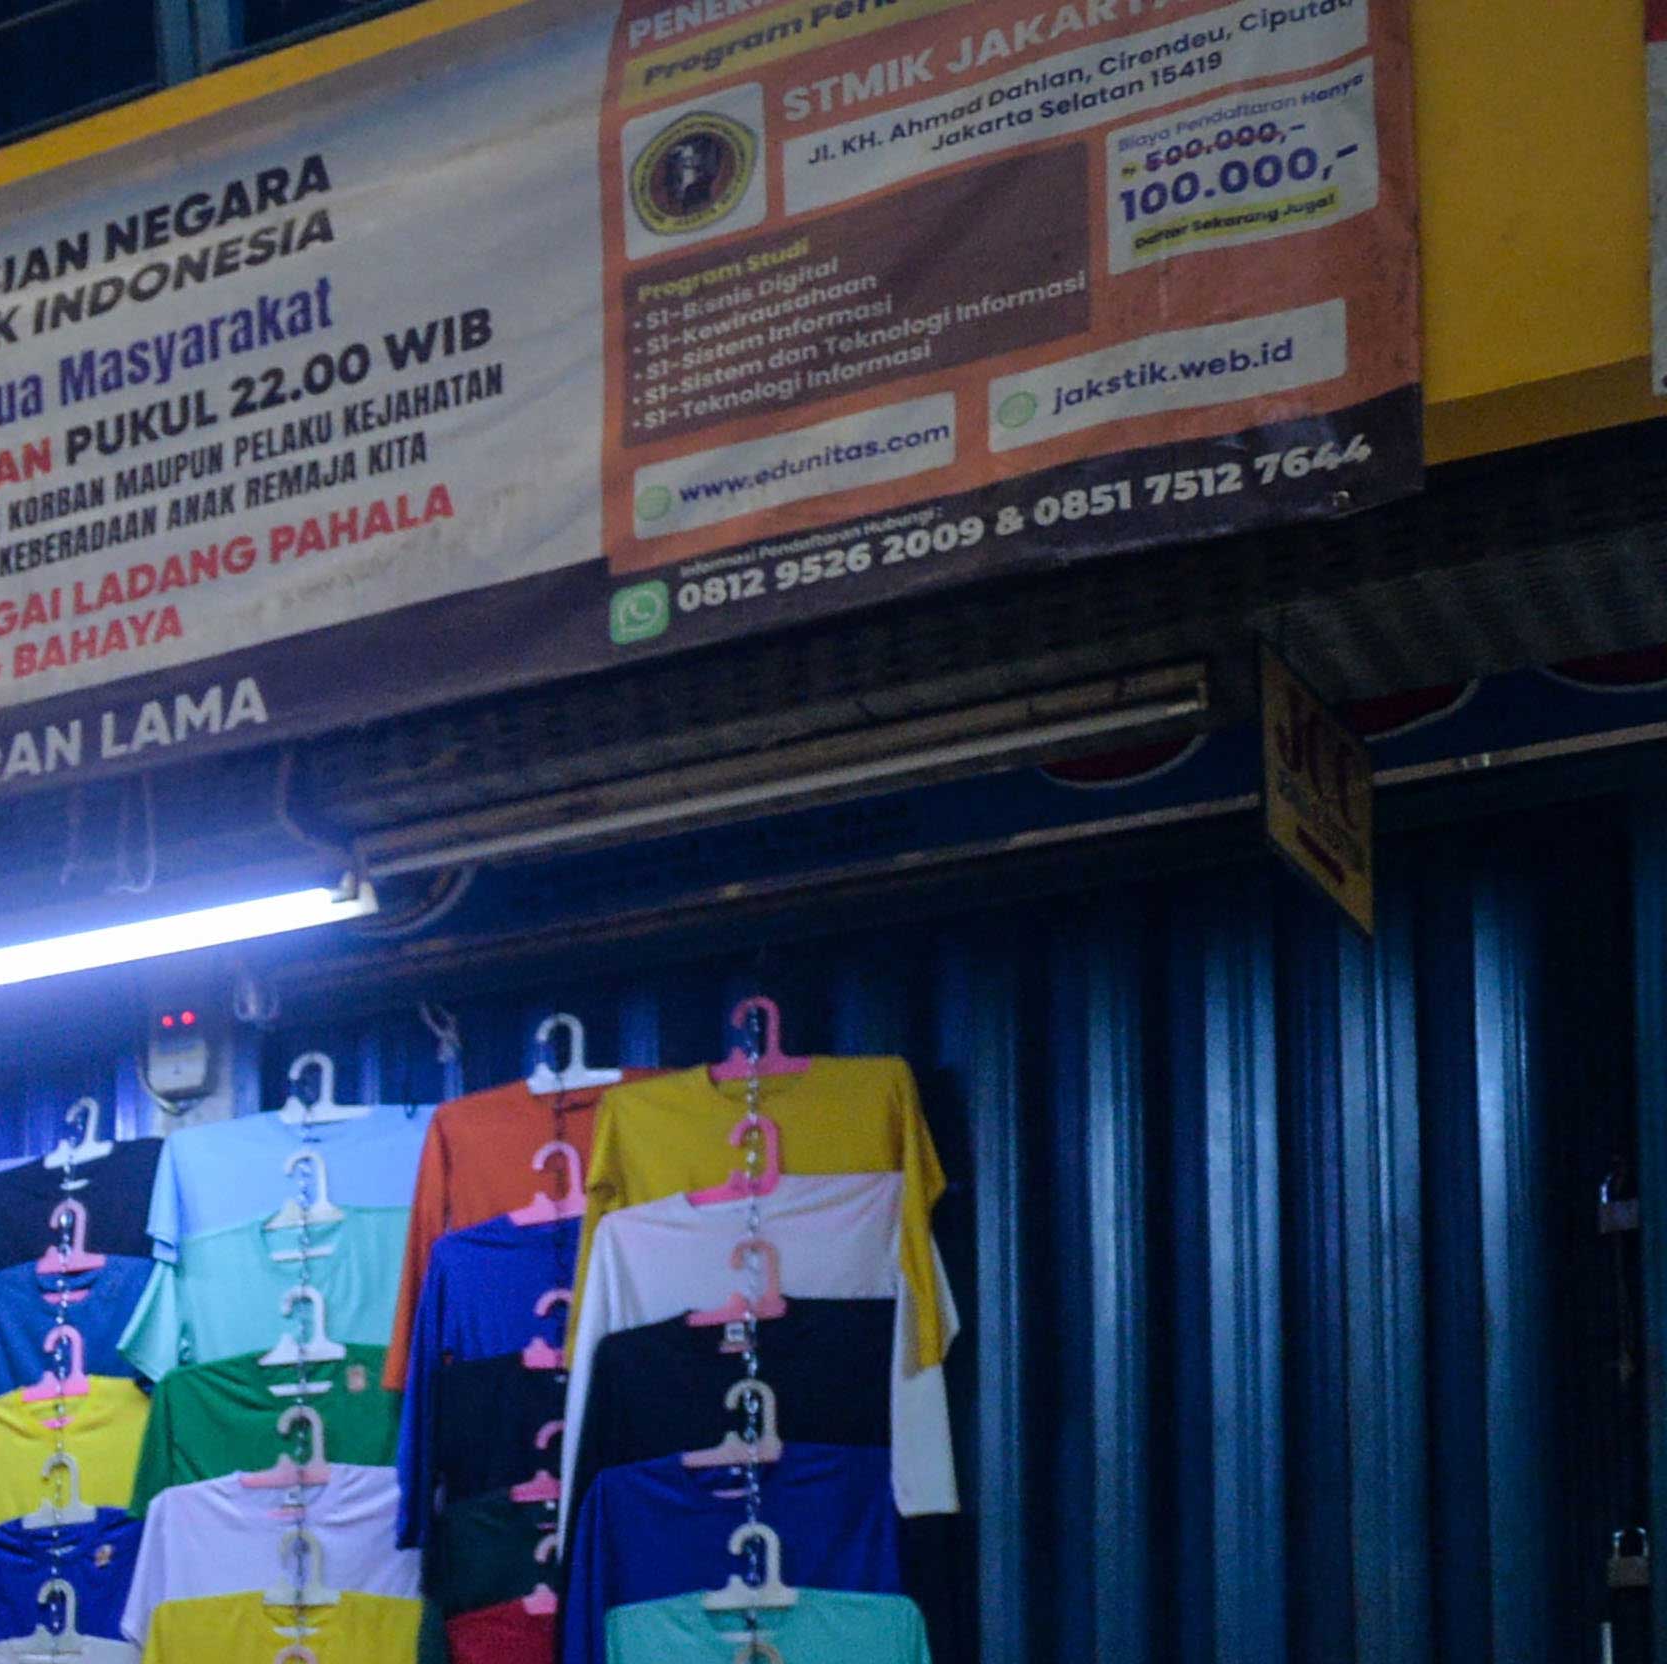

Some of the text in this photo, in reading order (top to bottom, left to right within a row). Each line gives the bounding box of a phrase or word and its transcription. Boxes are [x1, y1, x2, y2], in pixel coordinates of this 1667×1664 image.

[644, 17, 803, 86] Program
[782, 0, 1179, 122] STMIK JAKAR
[842, 130, 882, 157] KH.
[890, 98, 982, 143] Ahmad
[988, 66, 1092, 108] Dahlan,
[1098, 25, 1233, 78] Cirendeu,
[930, 52, 1223, 151] Jakarta Selatan 15419
[1118, 72, 1365, 155] Biaya Pendaftaran Hanya
[104, 154, 332, 262] NEGARA
[1119, 143, 1359, 223] 100.000,-
[1134, 192, 1336, 251] Daftar Sekarang Juga!
[31, 208, 336, 336] INDONESIA
[637, 236, 810, 302] Program Studi
[758, 256, 839, 298] Digital
[58, 277, 333, 405] Masyarakat
[768, 341, 819, 369] dan
[823, 308, 951, 349] Teknologi
[955, 270, 1086, 322] Informasi
[769, 295, 893, 342] Informasi
[66, 388, 218, 466] PUKUL
[229, 343, 371, 418] 22.00
[383, 308, 493, 371] WIB
[805, 341, 932, 388] Informasi
[1052, 336, 1295, 415] jakstik.web.id
[7, 477, 106, 533] KORBAN
[113, 442, 224, 502] MAUPUN
[233, 411, 333, 470] PELAKU
[343, 362, 503, 439] KEJAHATAN
[166, 483, 237, 533] ANAK
[244, 448, 357, 511] REMAJA
[367, 431, 427, 477] KITA
[678, 423, 951, 504] www.edunitas.com
[72, 535, 257, 618] LADANG
[269, 482, 454, 565] PAHALA
[677, 432, 1372, 611] 0812 9526 2009 & 0851 7512 7644
[680, 549, 758, 579] Informasi
[761, 522, 861, 561] Pendaftaran
[864, 507, 935, 536] Hubungi
[12, 604, 184, 681] BAHAYA
[100, 676, 269, 761] LAMA
